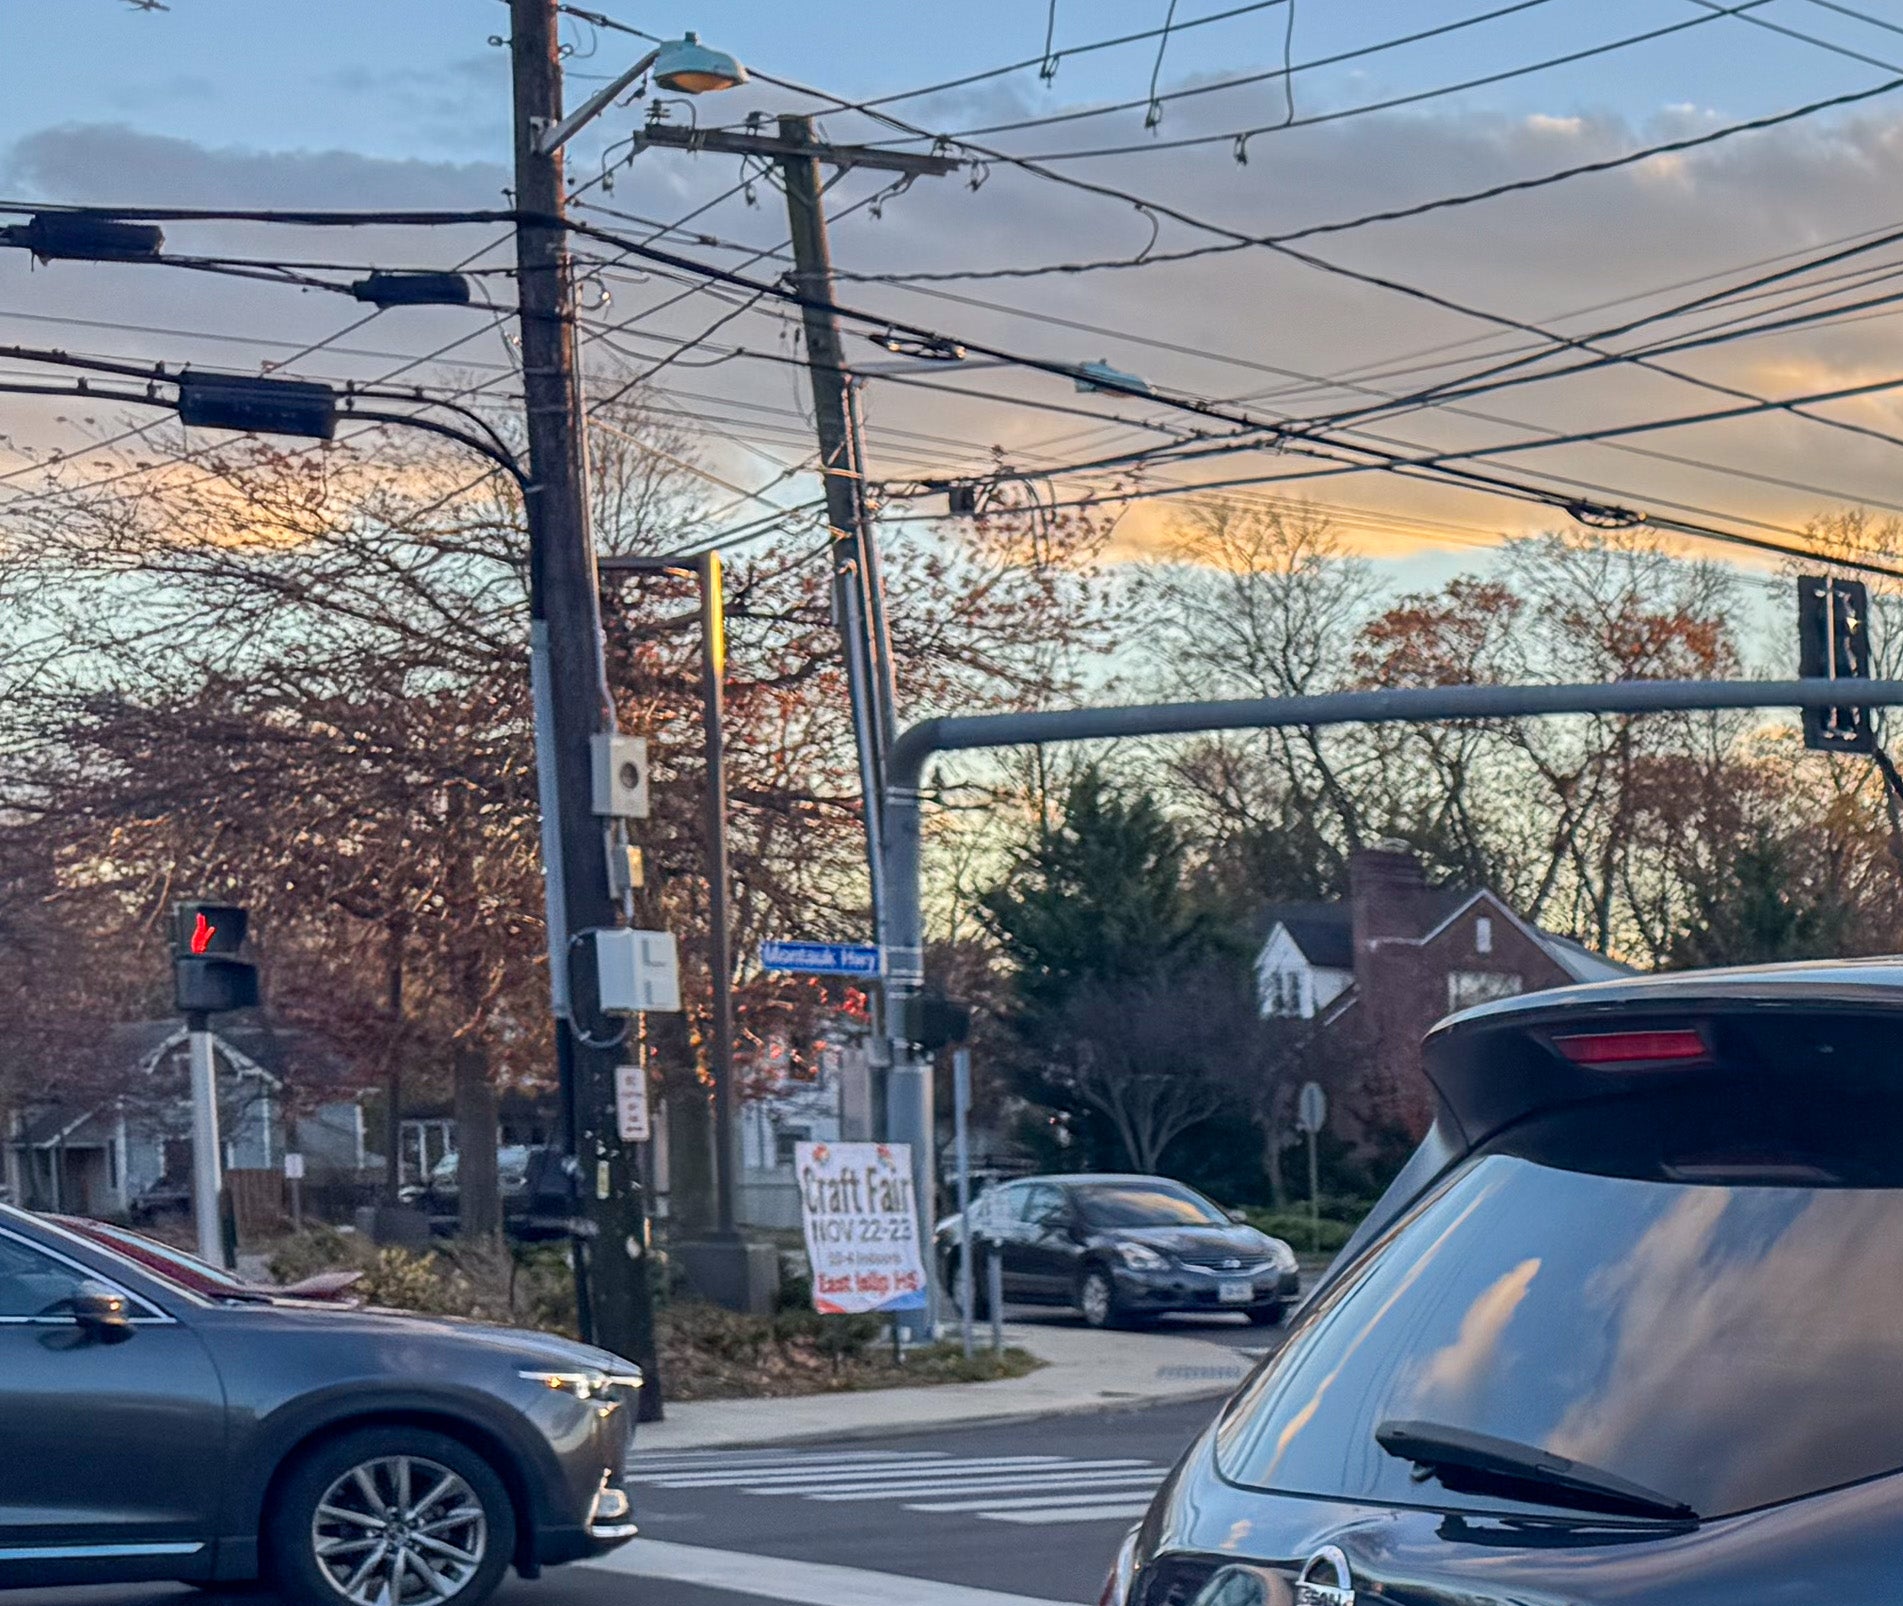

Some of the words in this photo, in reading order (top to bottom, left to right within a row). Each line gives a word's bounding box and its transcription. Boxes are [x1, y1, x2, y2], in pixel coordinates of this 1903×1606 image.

[803, 1166, 863, 1214] Craft
[866, 1166, 909, 1214] Fair
[811, 1218, 854, 1244] NOV
[858, 1218, 912, 1242] 22-23
